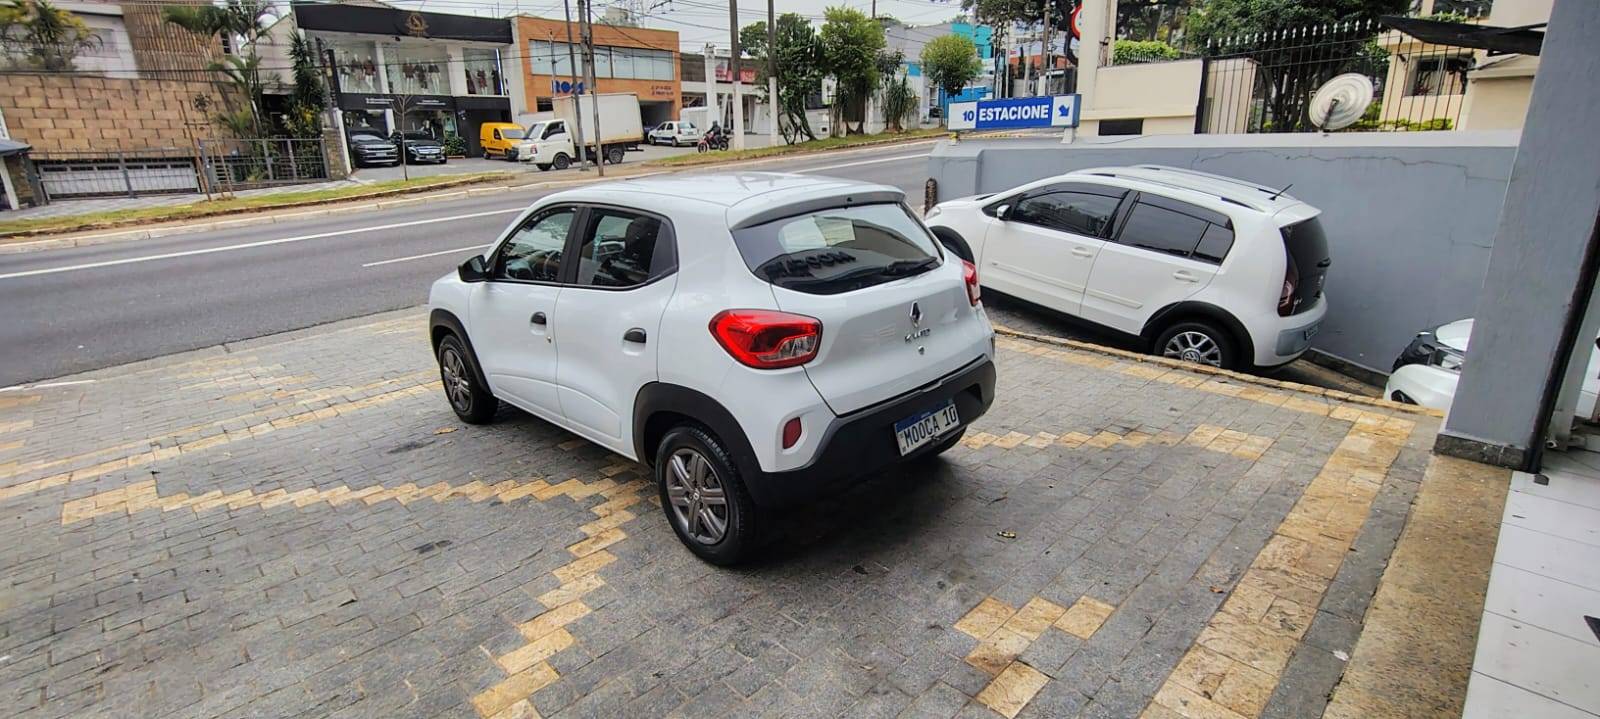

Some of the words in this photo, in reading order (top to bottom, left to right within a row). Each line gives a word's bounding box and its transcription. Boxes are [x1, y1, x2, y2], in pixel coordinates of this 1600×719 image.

[962, 110, 975, 122] 10
[978, 105, 1049, 121] ESTACIONE
[903, 415, 941, 448] MOOCA
[943, 406, 957, 427] 10
